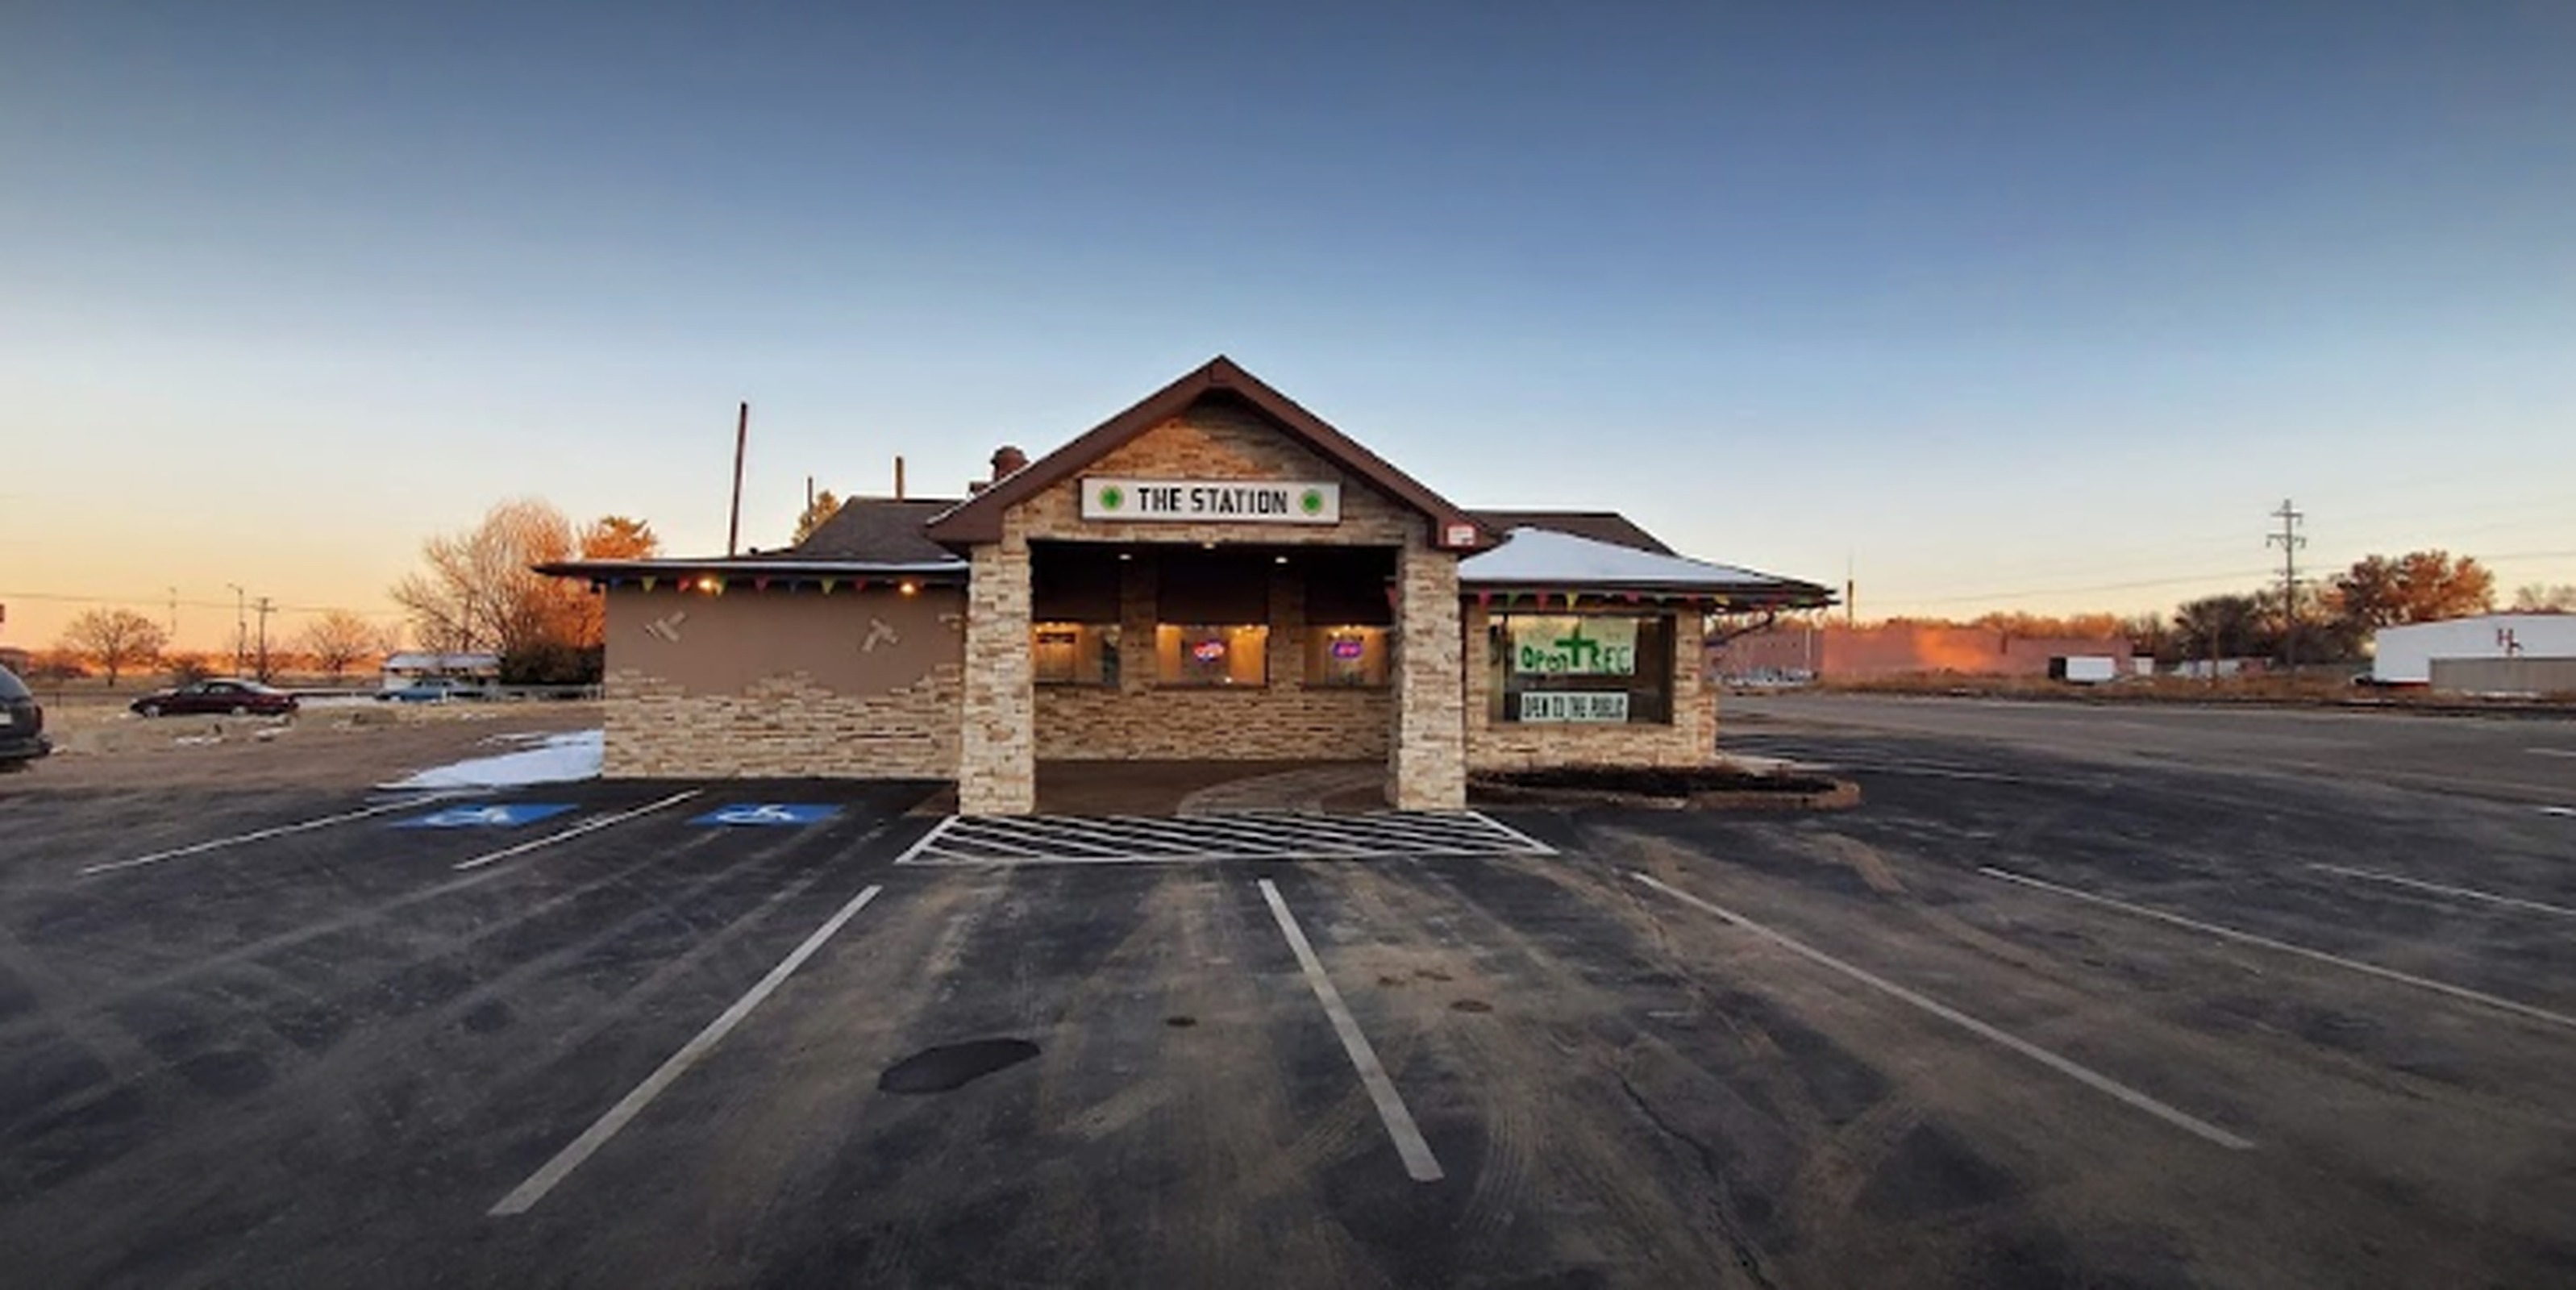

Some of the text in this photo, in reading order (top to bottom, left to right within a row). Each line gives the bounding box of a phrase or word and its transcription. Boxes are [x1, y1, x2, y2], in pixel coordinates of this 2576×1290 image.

[1138, 487, 1288, 514] THE STATION
[1524, 695, 1549, 718] OPEN
[1590, 695, 1625, 718] PUBLIC
